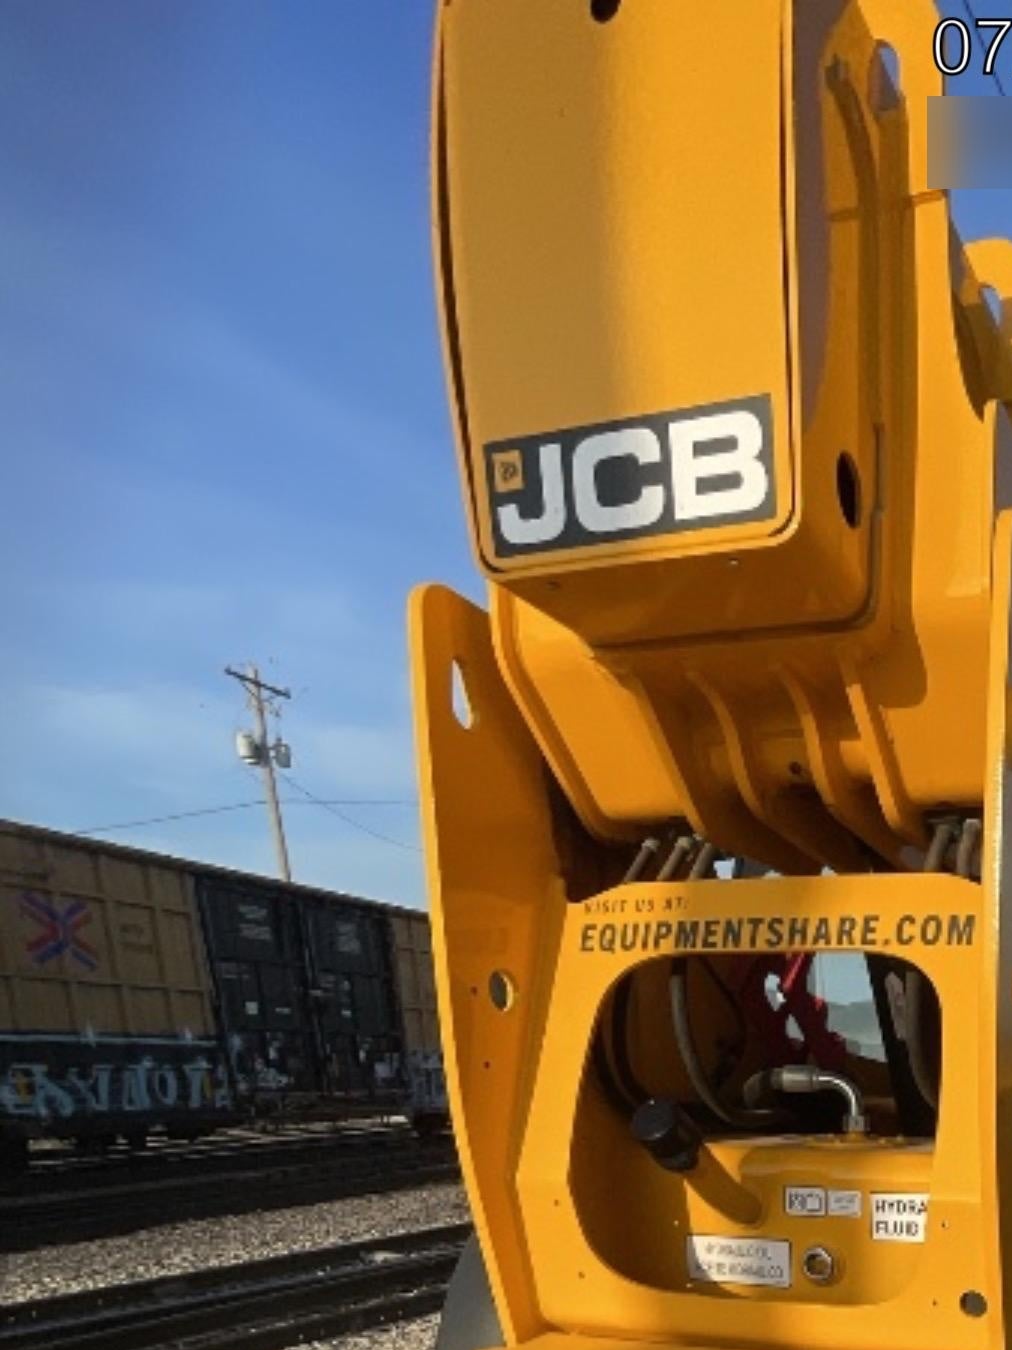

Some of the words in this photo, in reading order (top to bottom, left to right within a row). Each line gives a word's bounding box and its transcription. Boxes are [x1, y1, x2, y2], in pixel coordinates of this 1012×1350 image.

[497, 410, 768, 544] JCB
[634, 898, 655, 913] US
[580, 914, 976, 953] EQUIPMENTSHARE.COM
